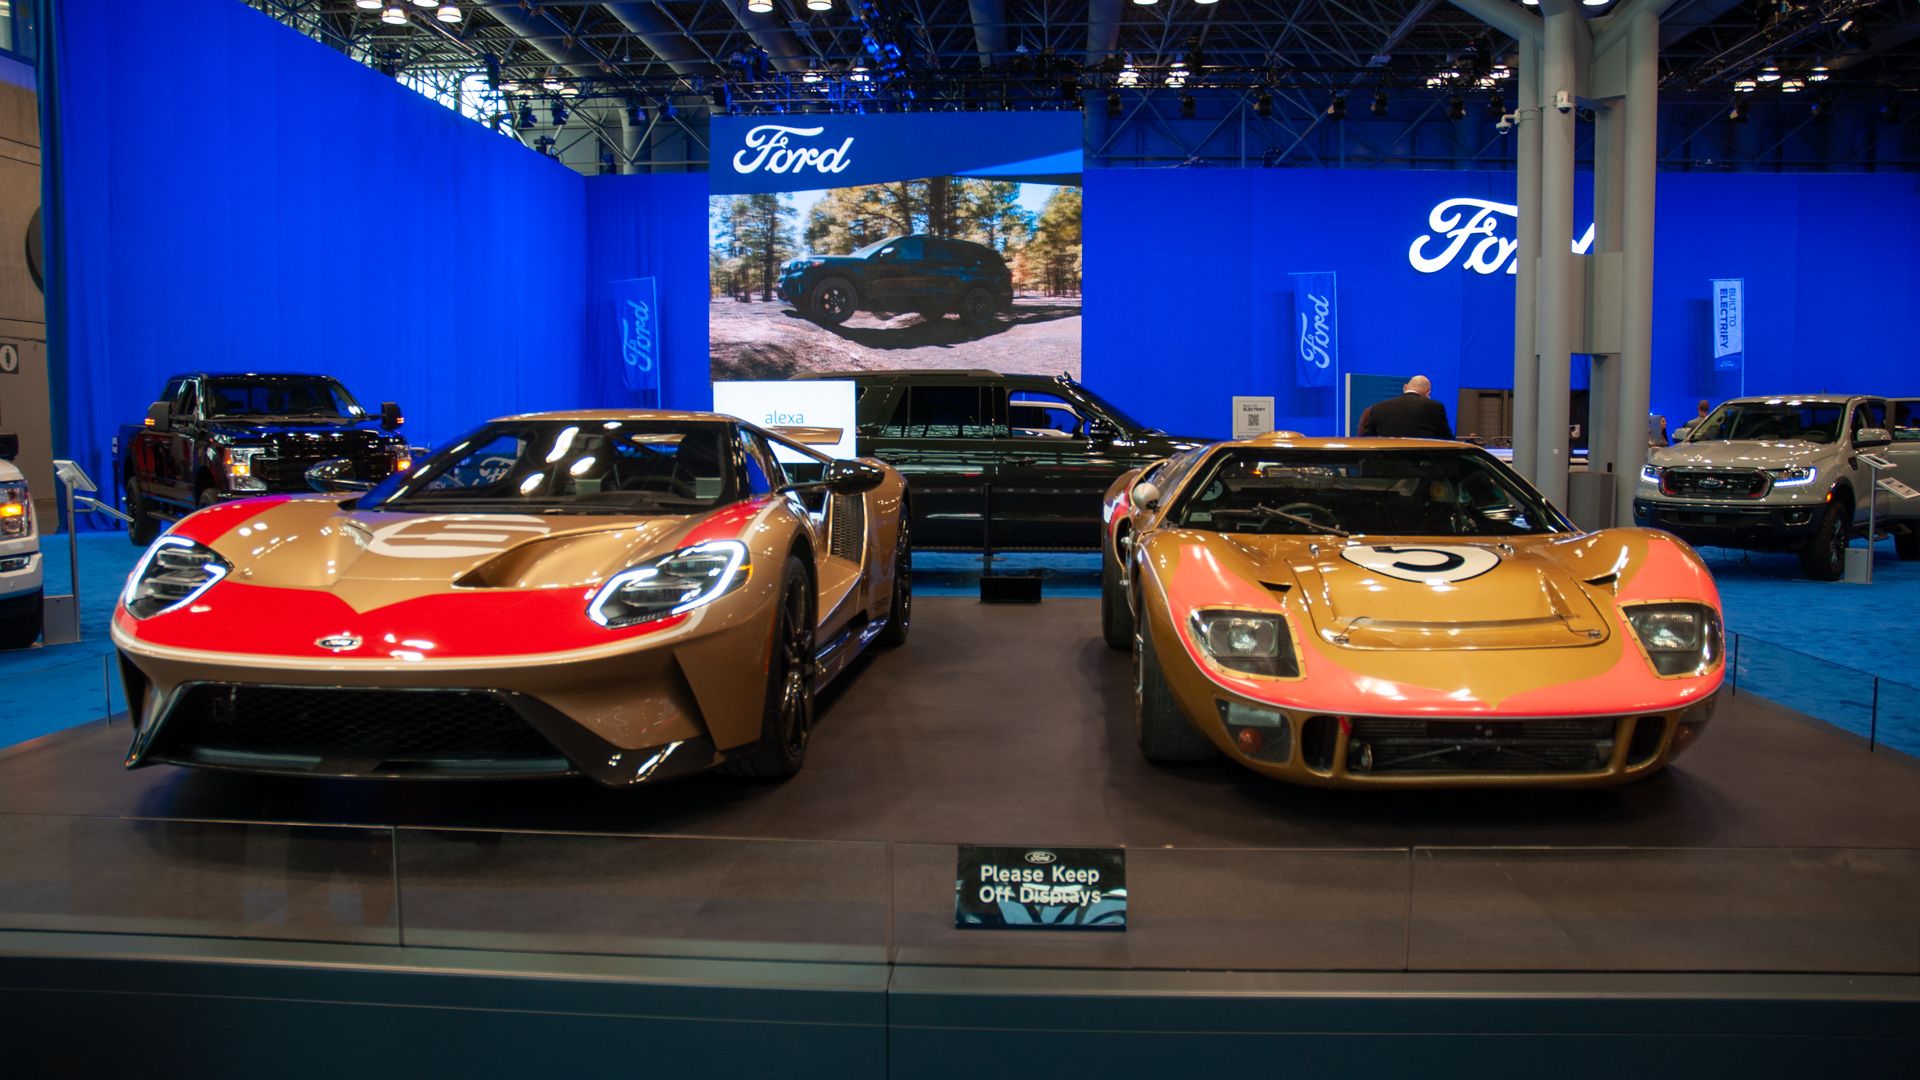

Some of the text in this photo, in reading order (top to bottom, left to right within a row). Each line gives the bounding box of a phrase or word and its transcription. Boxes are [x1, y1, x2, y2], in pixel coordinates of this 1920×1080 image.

[733, 125, 854, 173] Ford
[1409, 198, 1595, 274] Fo
[1720, 288, 1729, 349] ELECTRIFY
[1729, 288, 1737, 328] BUILT TO
[623, 300, 652, 372] Ford
[1300, 293, 1330, 369] Ford
[765, 410, 804, 424] alexa
[1372, 545, 1465, 573] 5
[979, 886, 1101, 907] Off Displays
[980, 865, 1100, 884] Please Keep
